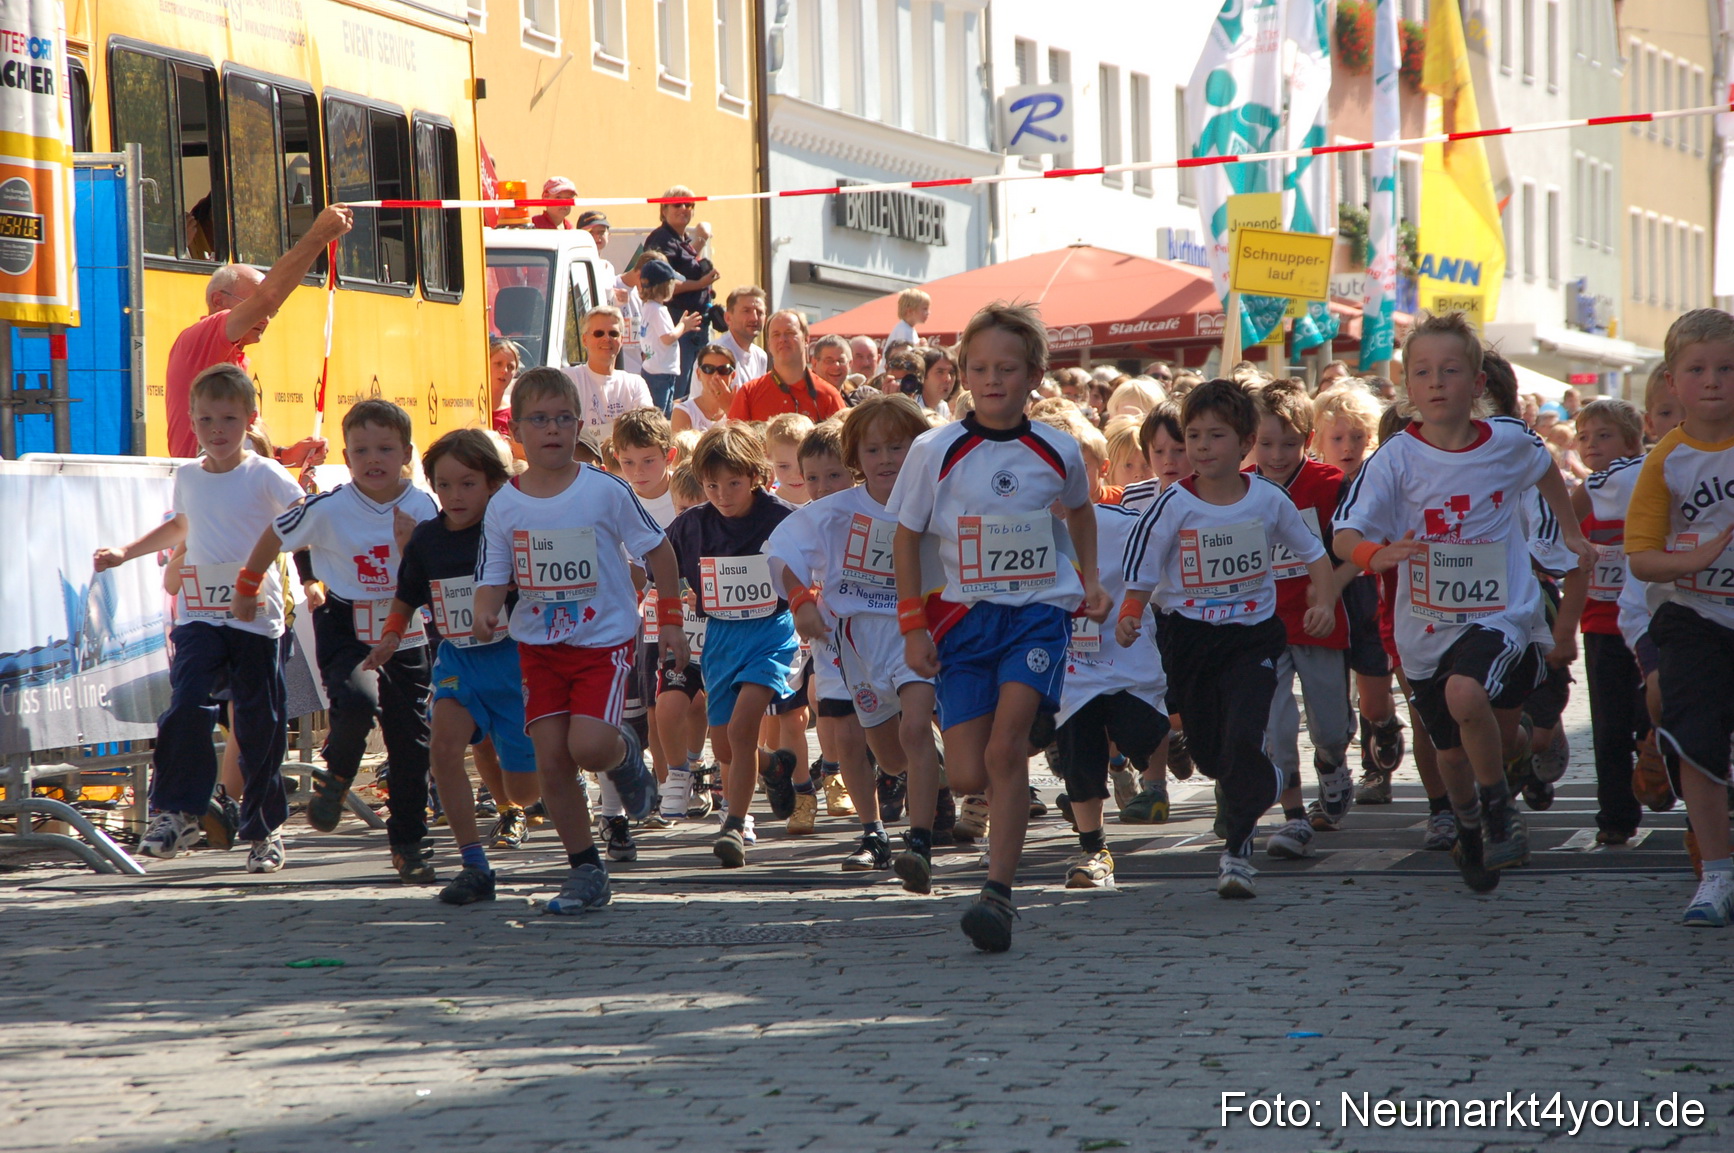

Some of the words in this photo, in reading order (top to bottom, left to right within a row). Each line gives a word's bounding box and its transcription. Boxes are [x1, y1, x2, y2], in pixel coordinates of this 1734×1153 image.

[342, 19, 374, 60] EVENT
[377, 29, 417, 72] SERVICE
[0, 59, 54, 95] CKER
[846, 181, 899, 237] BRILLEN
[899, 191, 948, 246] WEBER
[1242, 245, 1325, 267] Schnupper-
[1267, 266, 1296, 281] lauf
[1418, 252, 1482, 287] ANN
[1438, 298, 1479, 313] Block
[1107, 316, 1181, 336] Stadtcafé
[986, 523, 1032, 535] Tobias
[532, 536, 554, 551] Luis
[1202, 533, 1233, 548] Fabio
[987, 545, 1049, 572] 7287
[1271, 544, 1298, 562] 72
[1433, 552, 1473, 568] Simon
[517, 557, 527, 569] K2
[536, 559, 591, 582] 7060
[719, 563, 748, 576] Josua
[1183, 556, 1195, 568] K2
[1207, 550, 1263, 578] 7065
[1020, 577, 1057, 588] PFLEIDERER
[1413, 571, 1424, 584] K2
[205, 584, 235, 603] 72
[444, 585, 473, 599] Aaron
[704, 582, 713, 592] K2
[722, 582, 772, 603] 7090
[839, 583, 853, 595] 8.
[1435, 579, 1500, 603] 7042
[450, 608, 473, 629] 70
[645, 610, 655, 618] K2
[46, 677, 72, 712] the
[76, 675, 112, 709] line.
